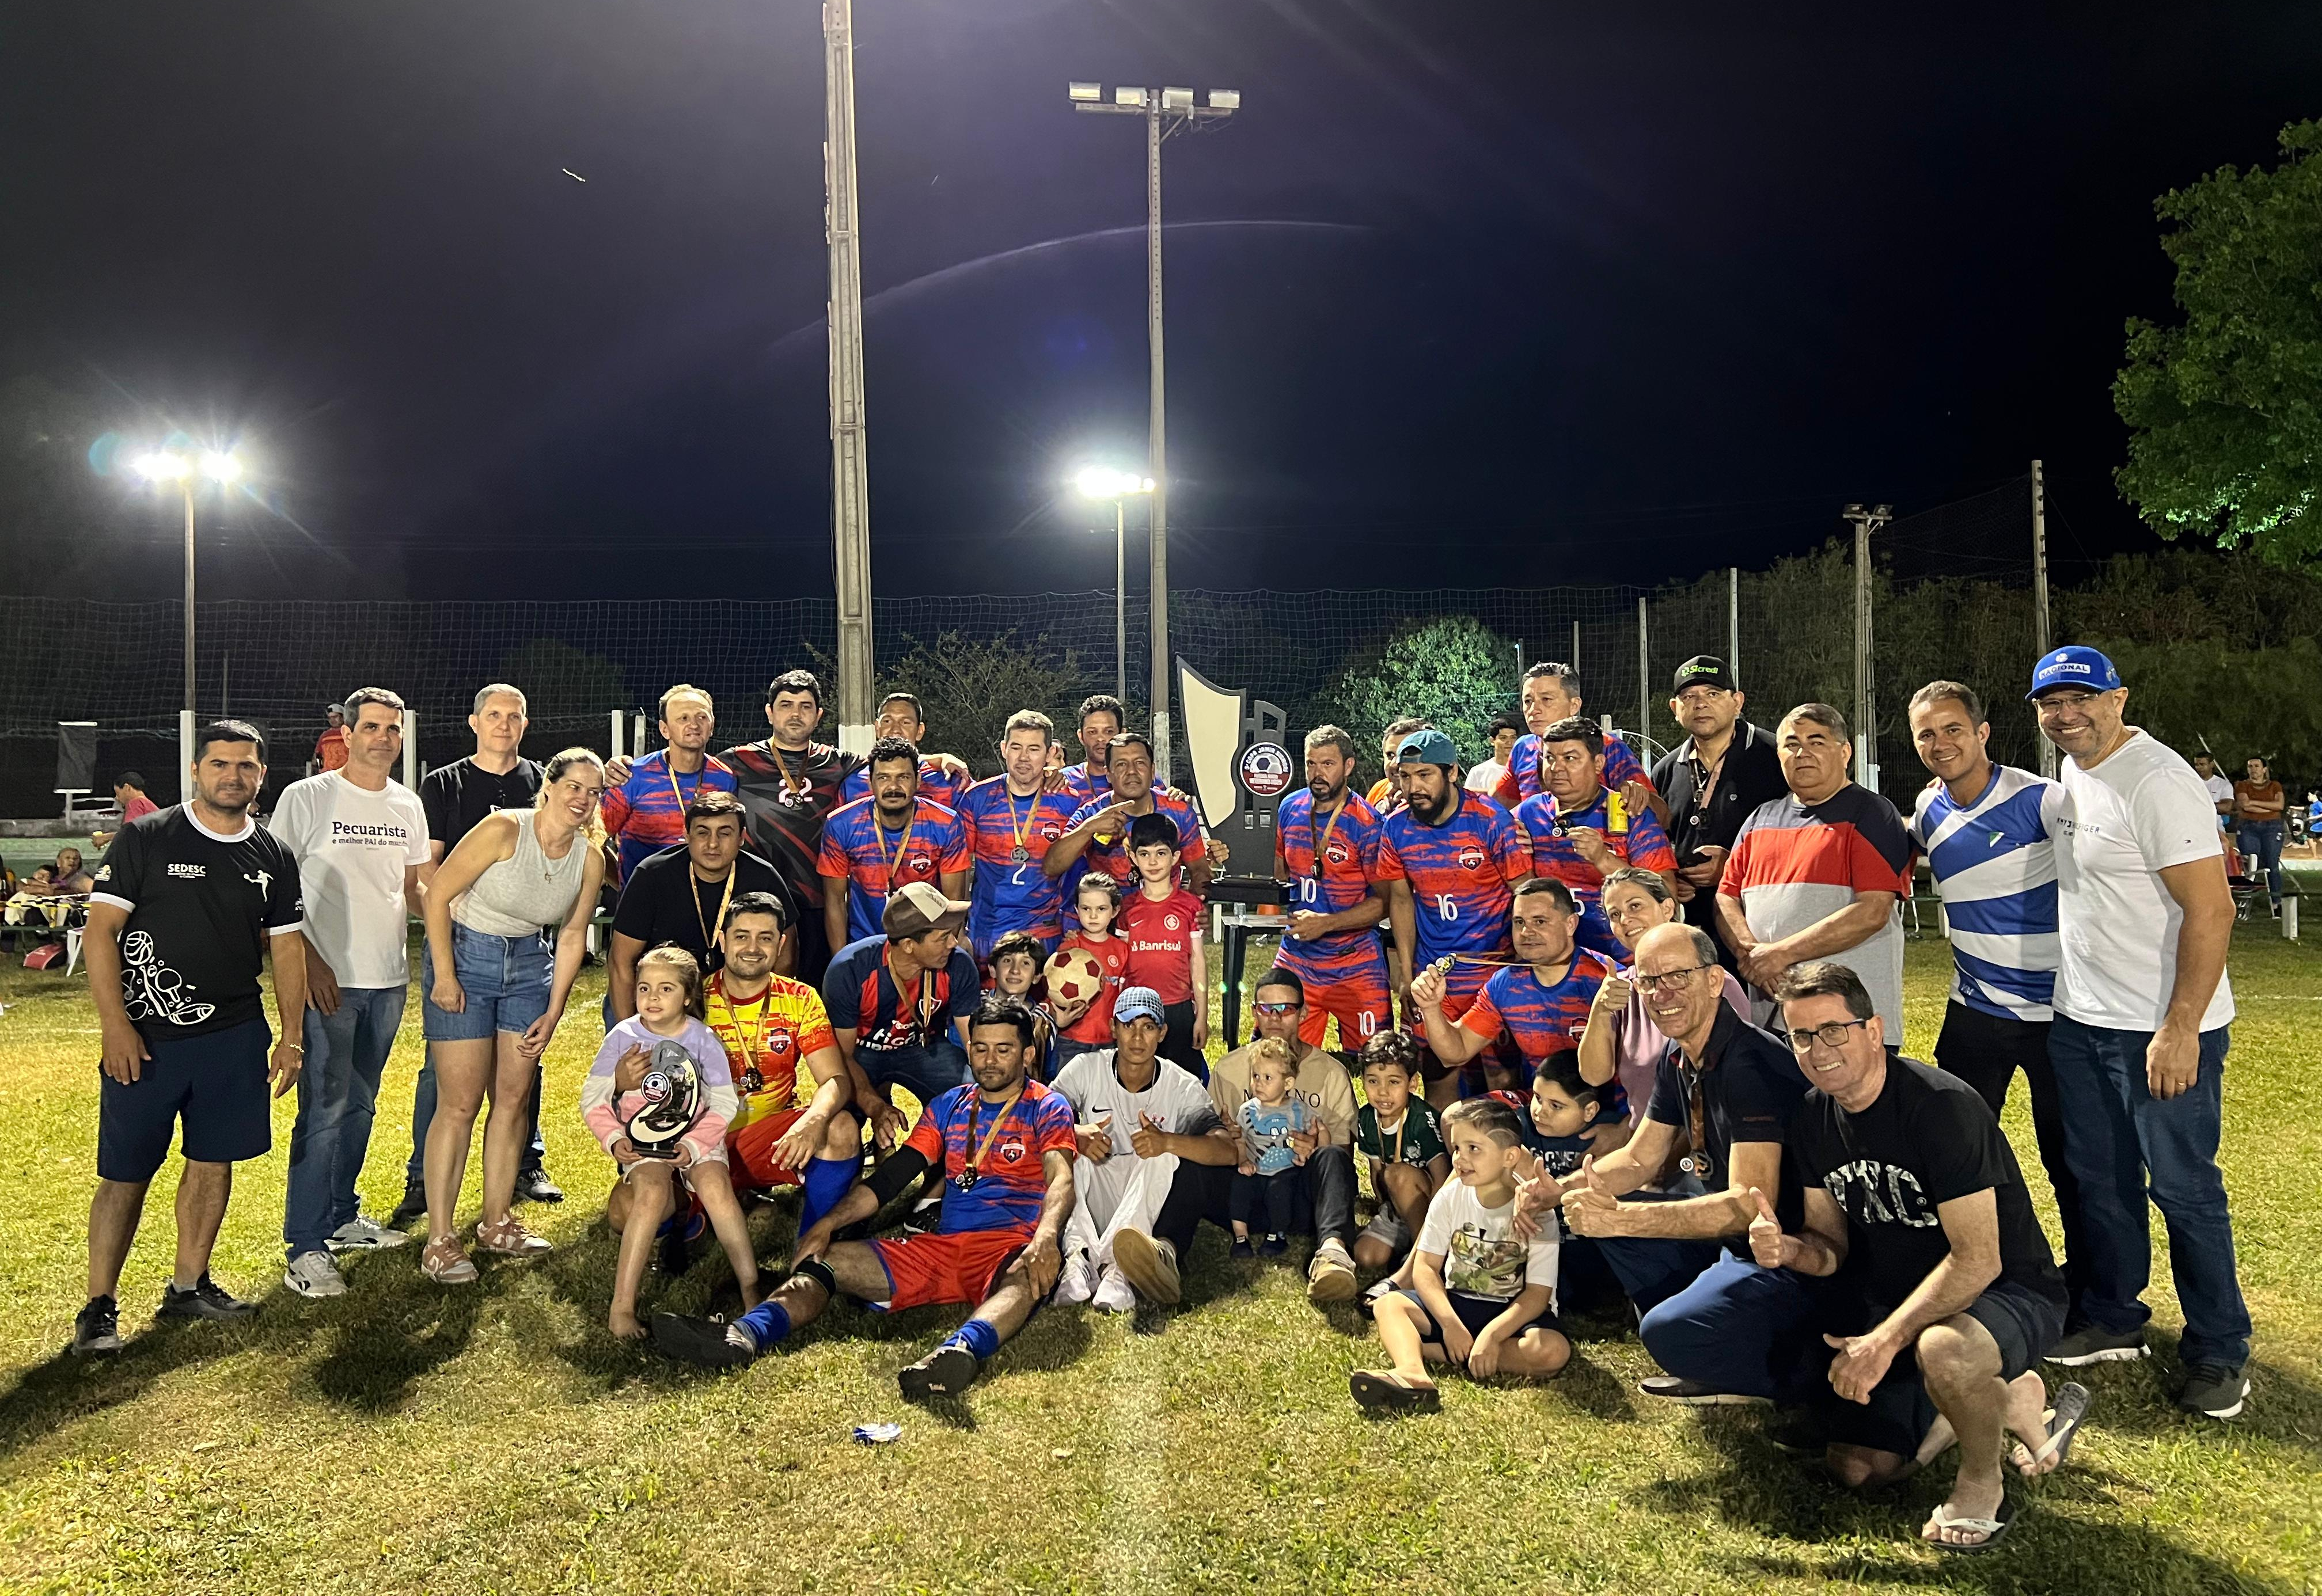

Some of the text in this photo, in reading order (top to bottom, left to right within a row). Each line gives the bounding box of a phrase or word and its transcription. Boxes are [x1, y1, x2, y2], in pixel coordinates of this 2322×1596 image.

[332, 822, 407, 838] Pecuarista
[168, 864, 206, 874] SEDESC
[1299, 876, 1316, 903] 10
[1435, 894, 1458, 921] 16
[1139, 940, 1181, 951] Banrisul
[1356, 1010, 1375, 1036] 10
